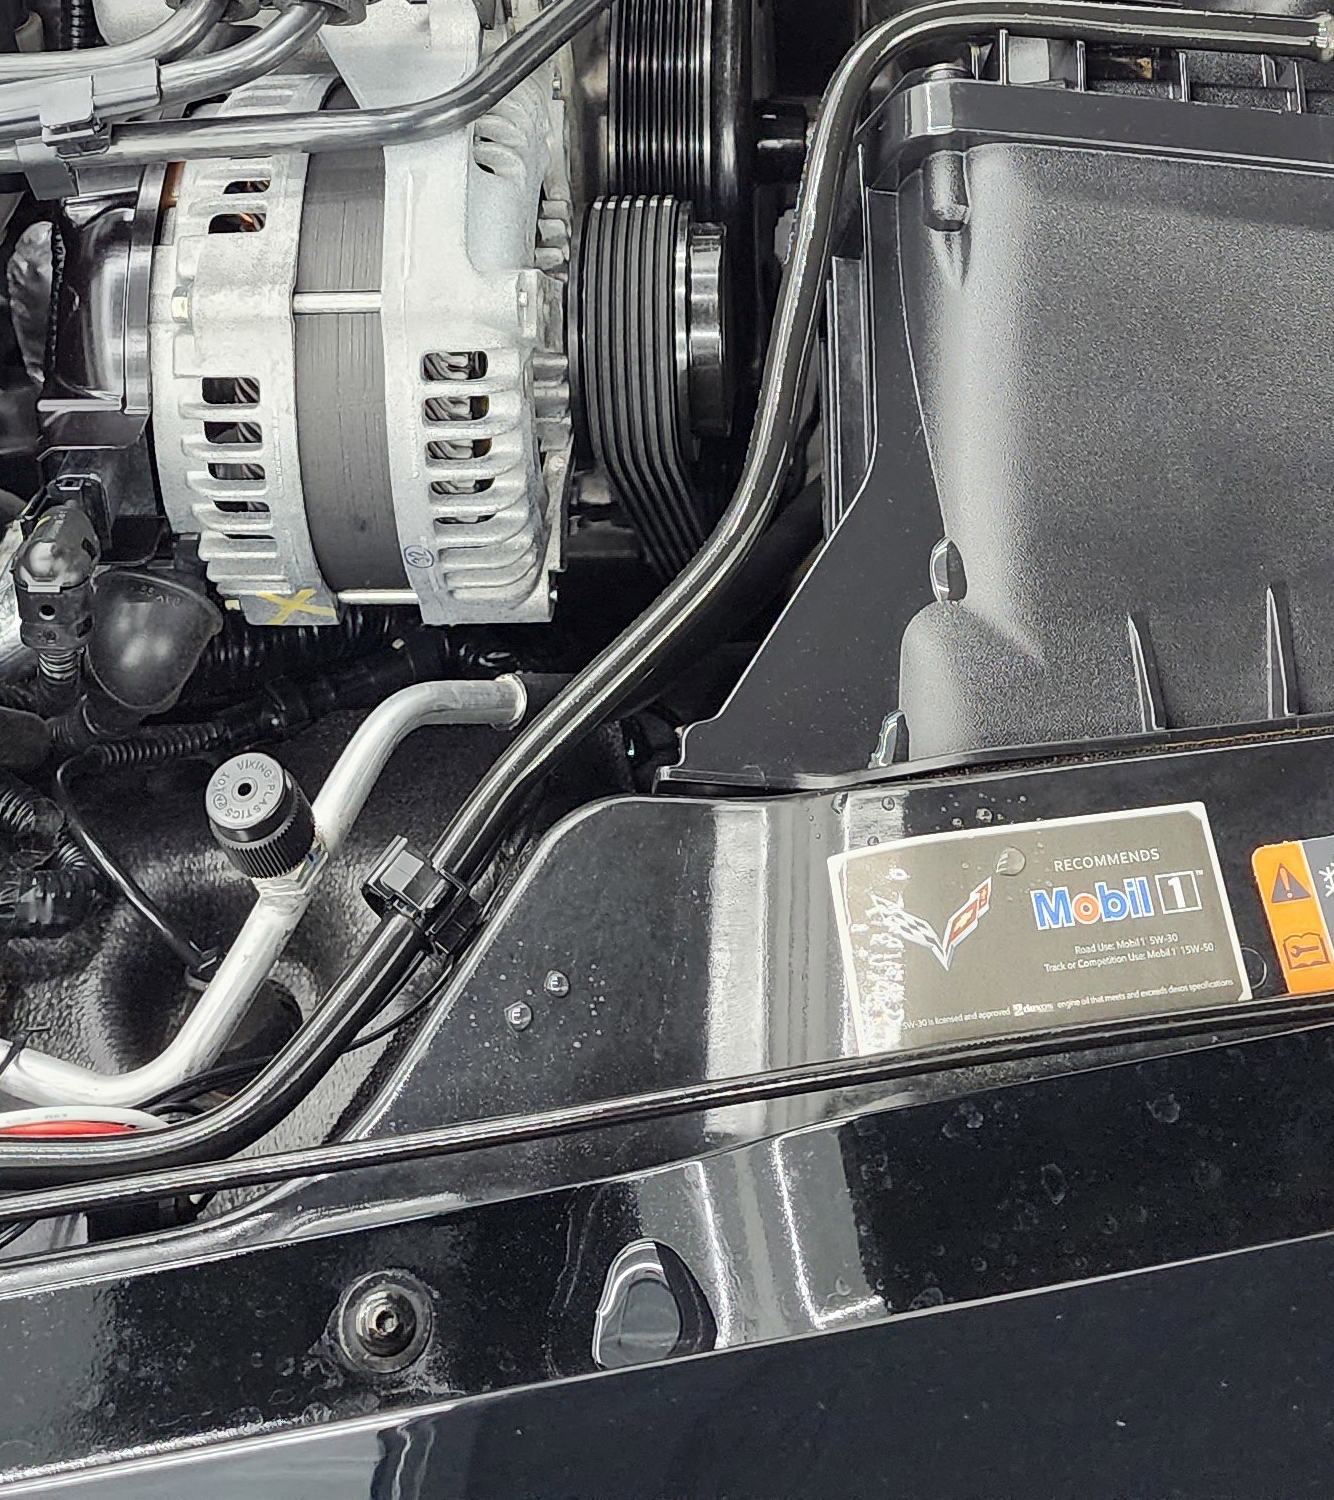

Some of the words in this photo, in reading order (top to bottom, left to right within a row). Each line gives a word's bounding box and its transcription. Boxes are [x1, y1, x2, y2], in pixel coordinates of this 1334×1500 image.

[236, 758, 273, 779] VIKING
[224, 784, 276, 820] PLASTICS
[1053, 847, 1161, 873] RECOMMENDS
[1030, 876, 1155, 931] Mobil
[1043, 962, 1067, 973] Track
[1067, 961, 1077, 970] or
[1077, 955, 1127, 969] Competition
[1128, 952, 1146, 963] Use:
[1180, 942, 1214, 956] 15W-50
[1074, 943, 1097, 955] Road
[1098, 941, 1115, 952] Use:
[1149, 932, 1179, 946] 5W-30
[935, 1013, 964, 1025] licensed
[964, 1011, 978, 1022] and
[978, 1008, 1011, 1020] approved
[1056, 998, 1081, 1010] engine
[1081, 995, 1090, 1006] oil
[1090, 994, 1104, 1005] that
[1104, 992, 1126, 1003] meets
[1127, 990, 1140, 1000] and
[1189, 978, 1235, 993] specifications
